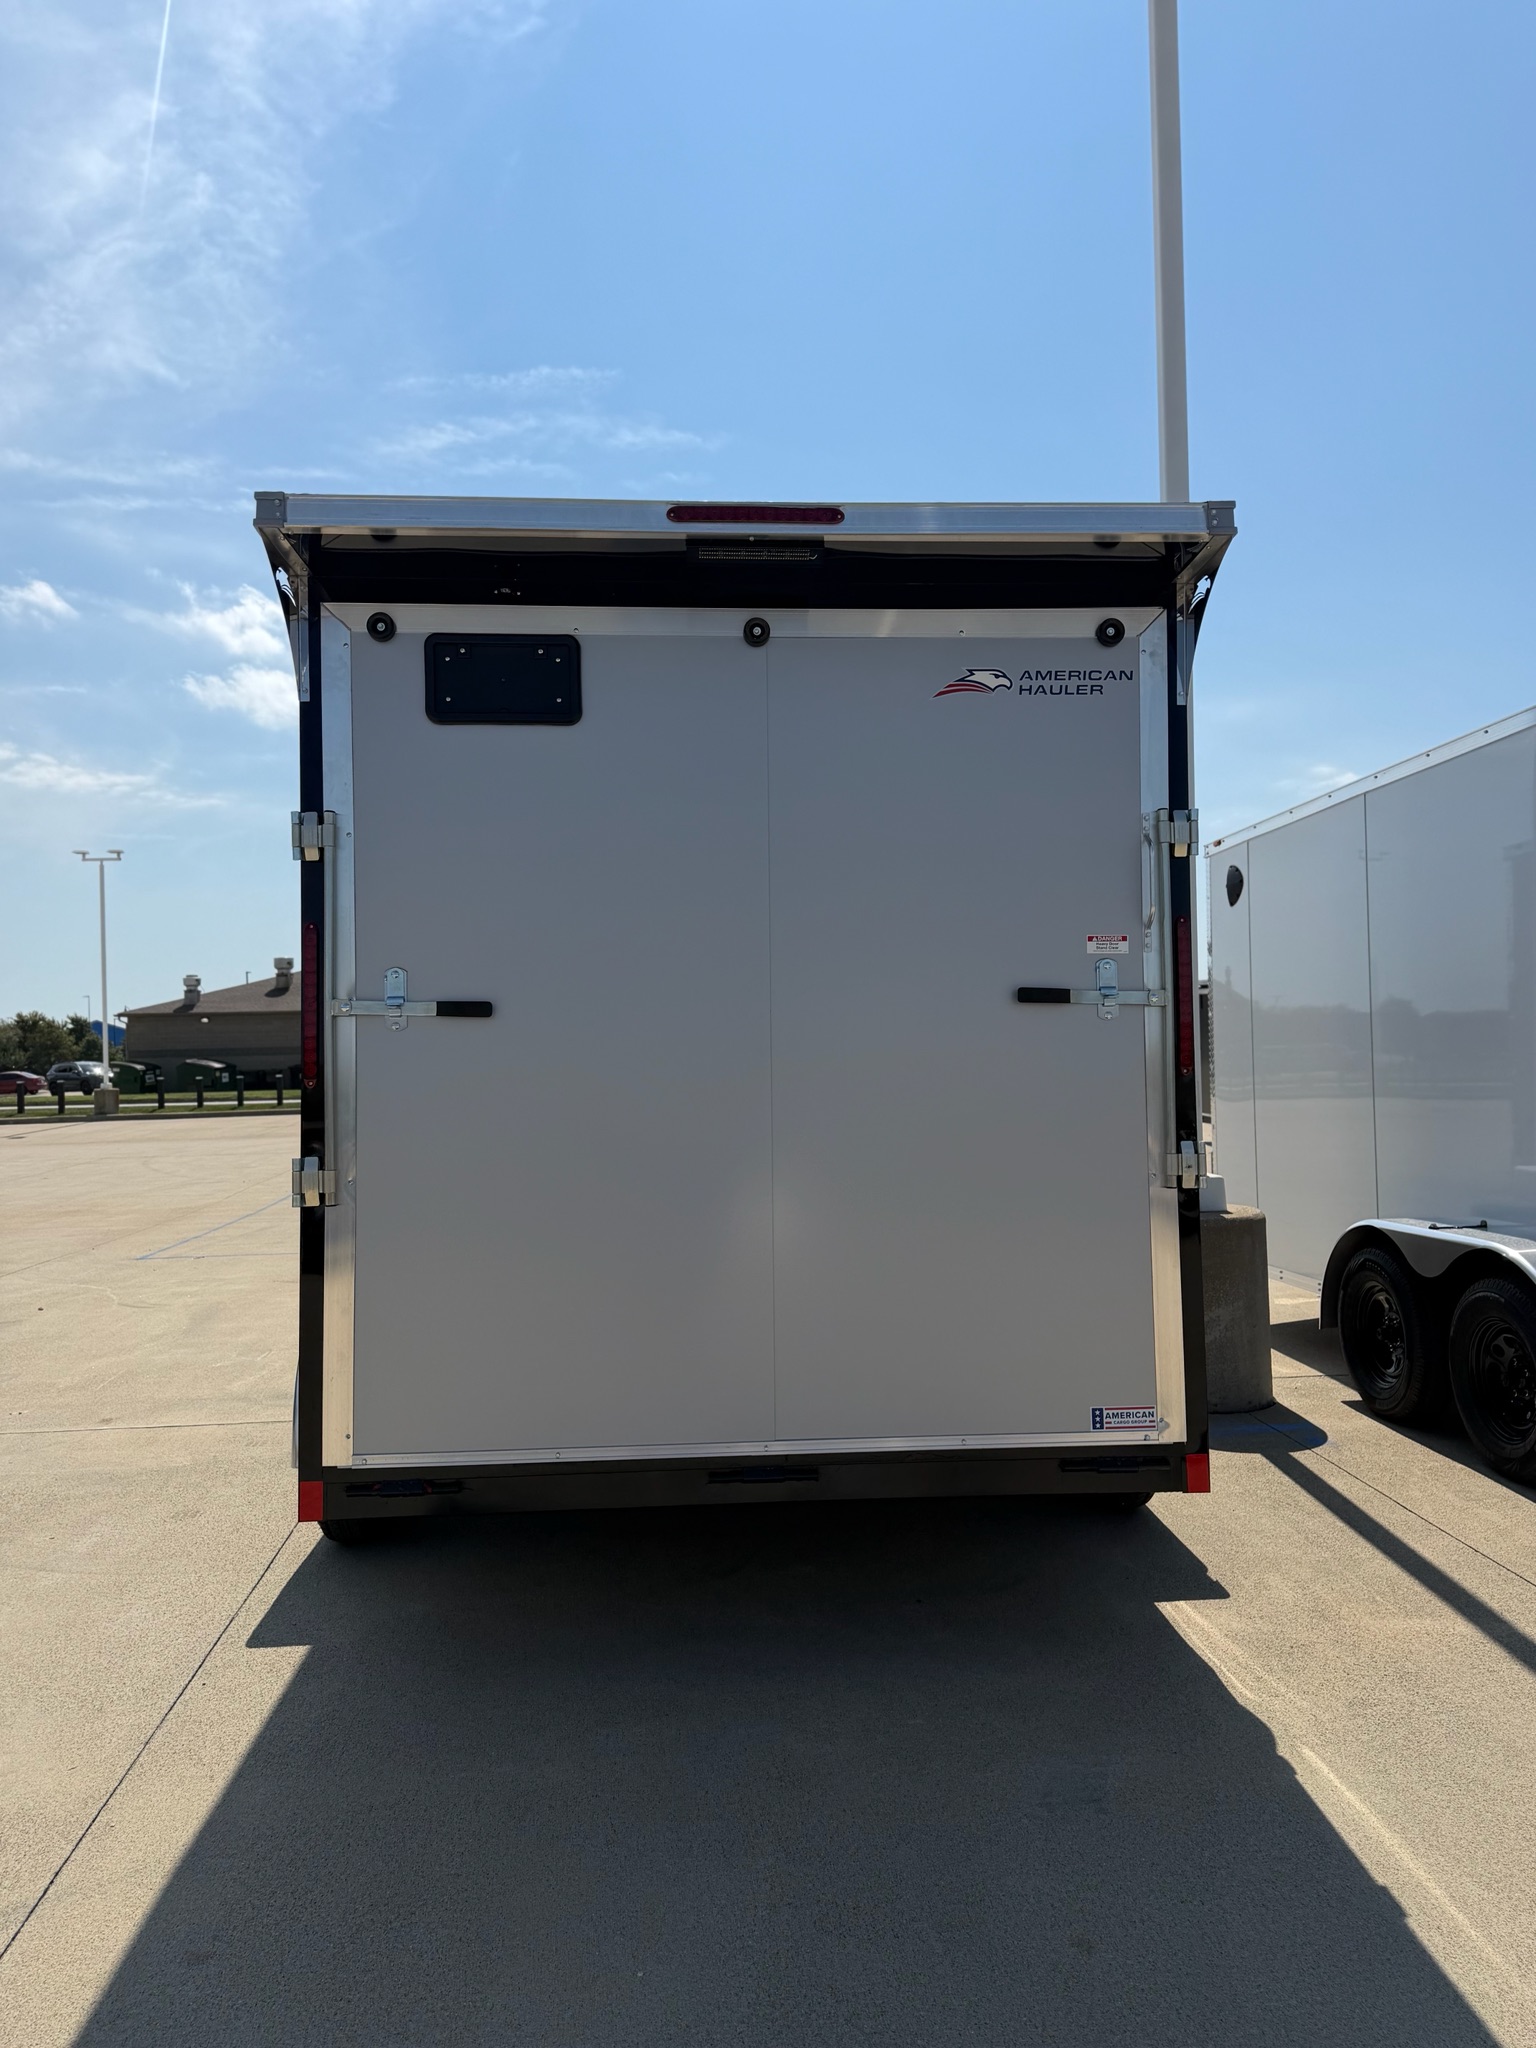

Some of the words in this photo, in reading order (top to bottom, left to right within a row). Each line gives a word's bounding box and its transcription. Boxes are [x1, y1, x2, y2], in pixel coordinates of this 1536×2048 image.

[1019, 670, 1134, 681] AMERICAN
[1019, 684, 1104, 695] HAULER
[1105, 1411, 1155, 1419] AMERICAN
